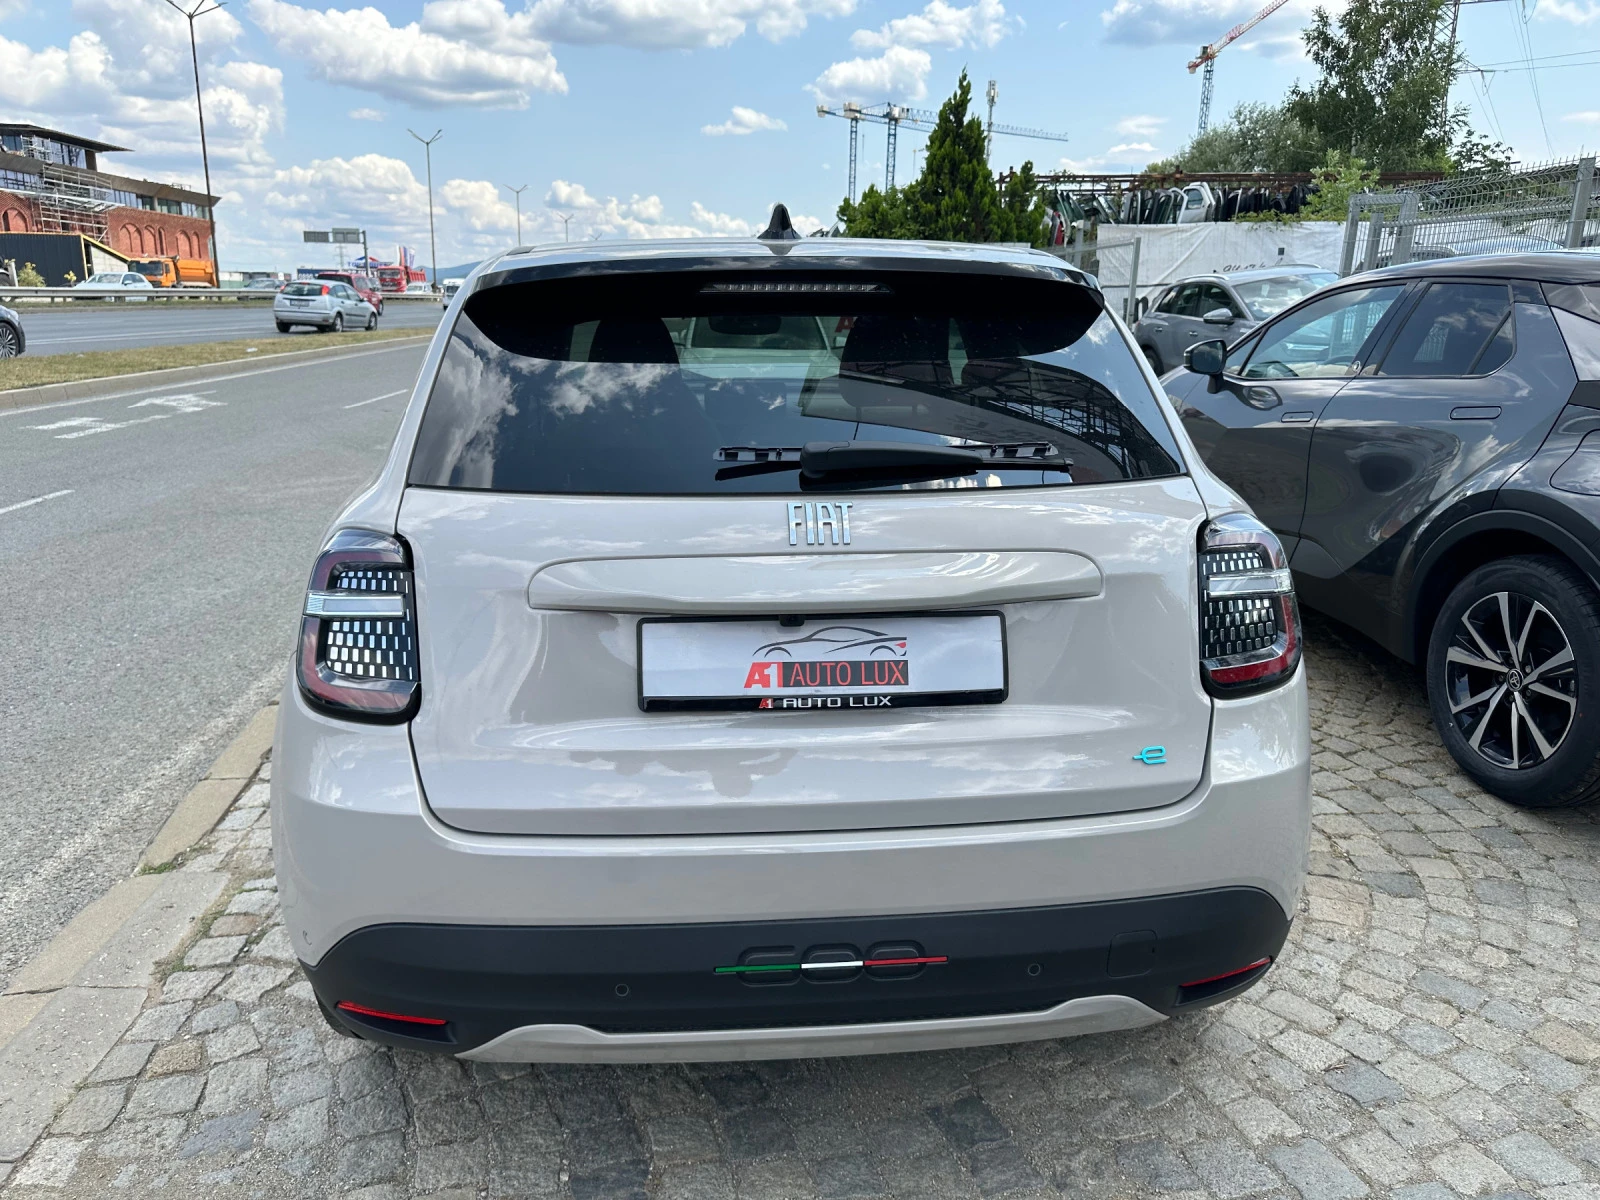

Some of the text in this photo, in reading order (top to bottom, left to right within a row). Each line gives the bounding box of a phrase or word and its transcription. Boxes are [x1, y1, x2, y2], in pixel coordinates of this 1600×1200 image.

[787, 502, 853, 546] FIAT
[744, 661, 906, 688] A1 AUTO LUX
[783, 697, 842, 709] AUTO
[849, 695, 892, 707] LUX
